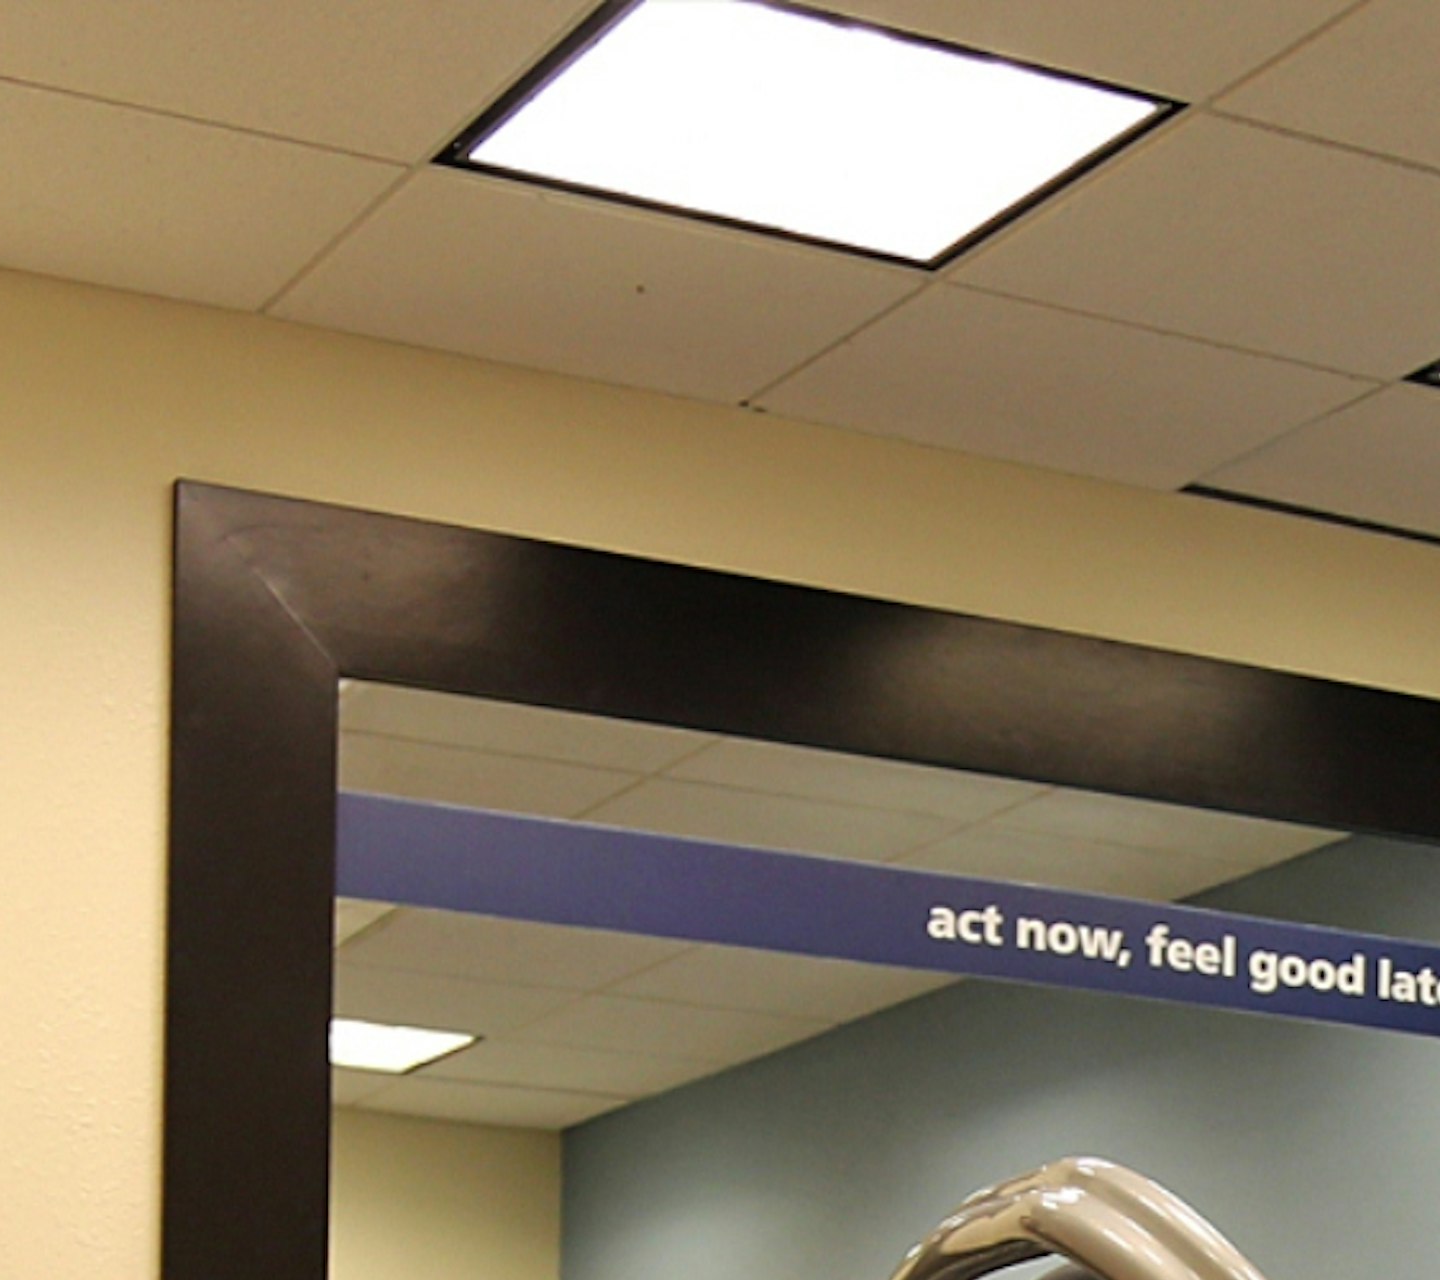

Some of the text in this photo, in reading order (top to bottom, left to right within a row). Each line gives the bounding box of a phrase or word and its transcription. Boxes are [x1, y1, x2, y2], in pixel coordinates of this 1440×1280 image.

[927, 904, 1003, 946] act
[1016, 910, 1131, 967] now,
[1145, 923, 1235, 977] feel
[1249, 948, 1365, 996] good
